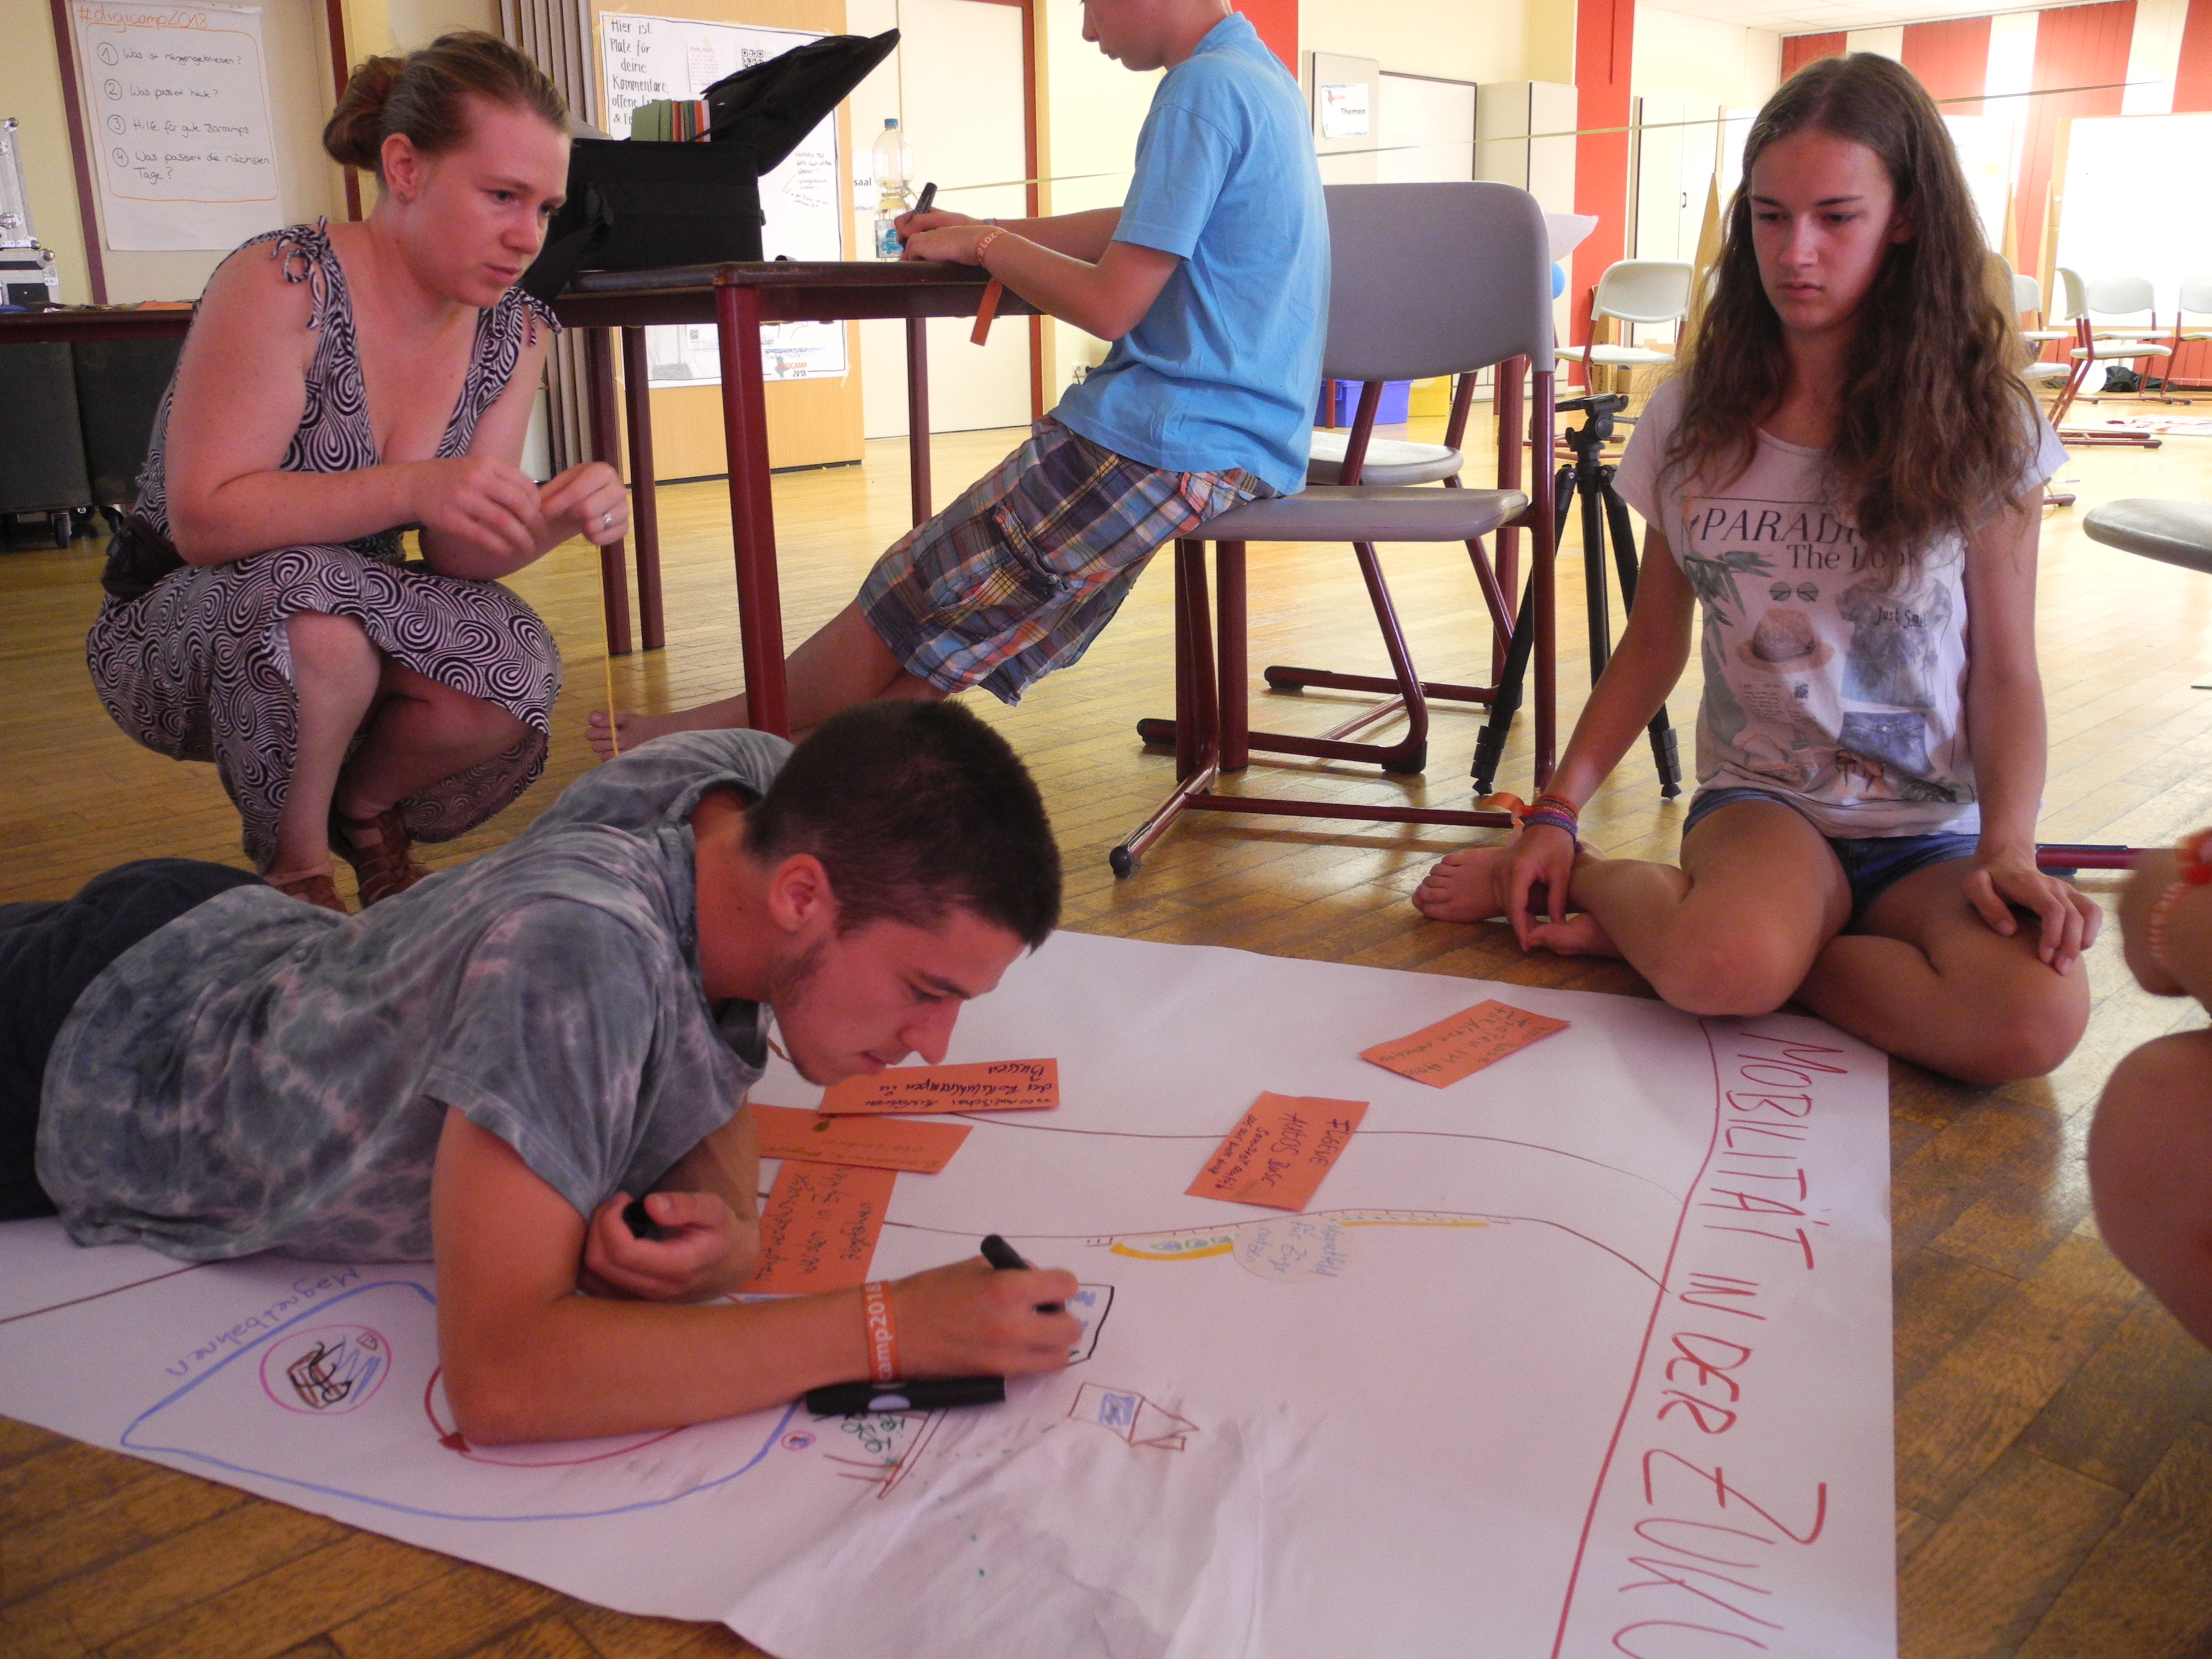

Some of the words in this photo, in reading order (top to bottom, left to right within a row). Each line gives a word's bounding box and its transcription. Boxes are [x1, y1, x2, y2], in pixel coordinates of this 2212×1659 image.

[611, 19, 632, 33] Hier
[638, 21, 652, 35] ist
[123, 48, 142, 59] Was
[609, 38, 632, 53] Platz
[637, 39, 651, 57] für
[620, 58, 648, 73] deine
[130, 84, 150, 96] Was
[612, 95, 637, 109] offene
[135, 151, 158, 162] Was
[1786, 543, 1841, 569] The
[1679, 1272, 1767, 1321] IN
[1656, 1332, 1754, 1435] DER
